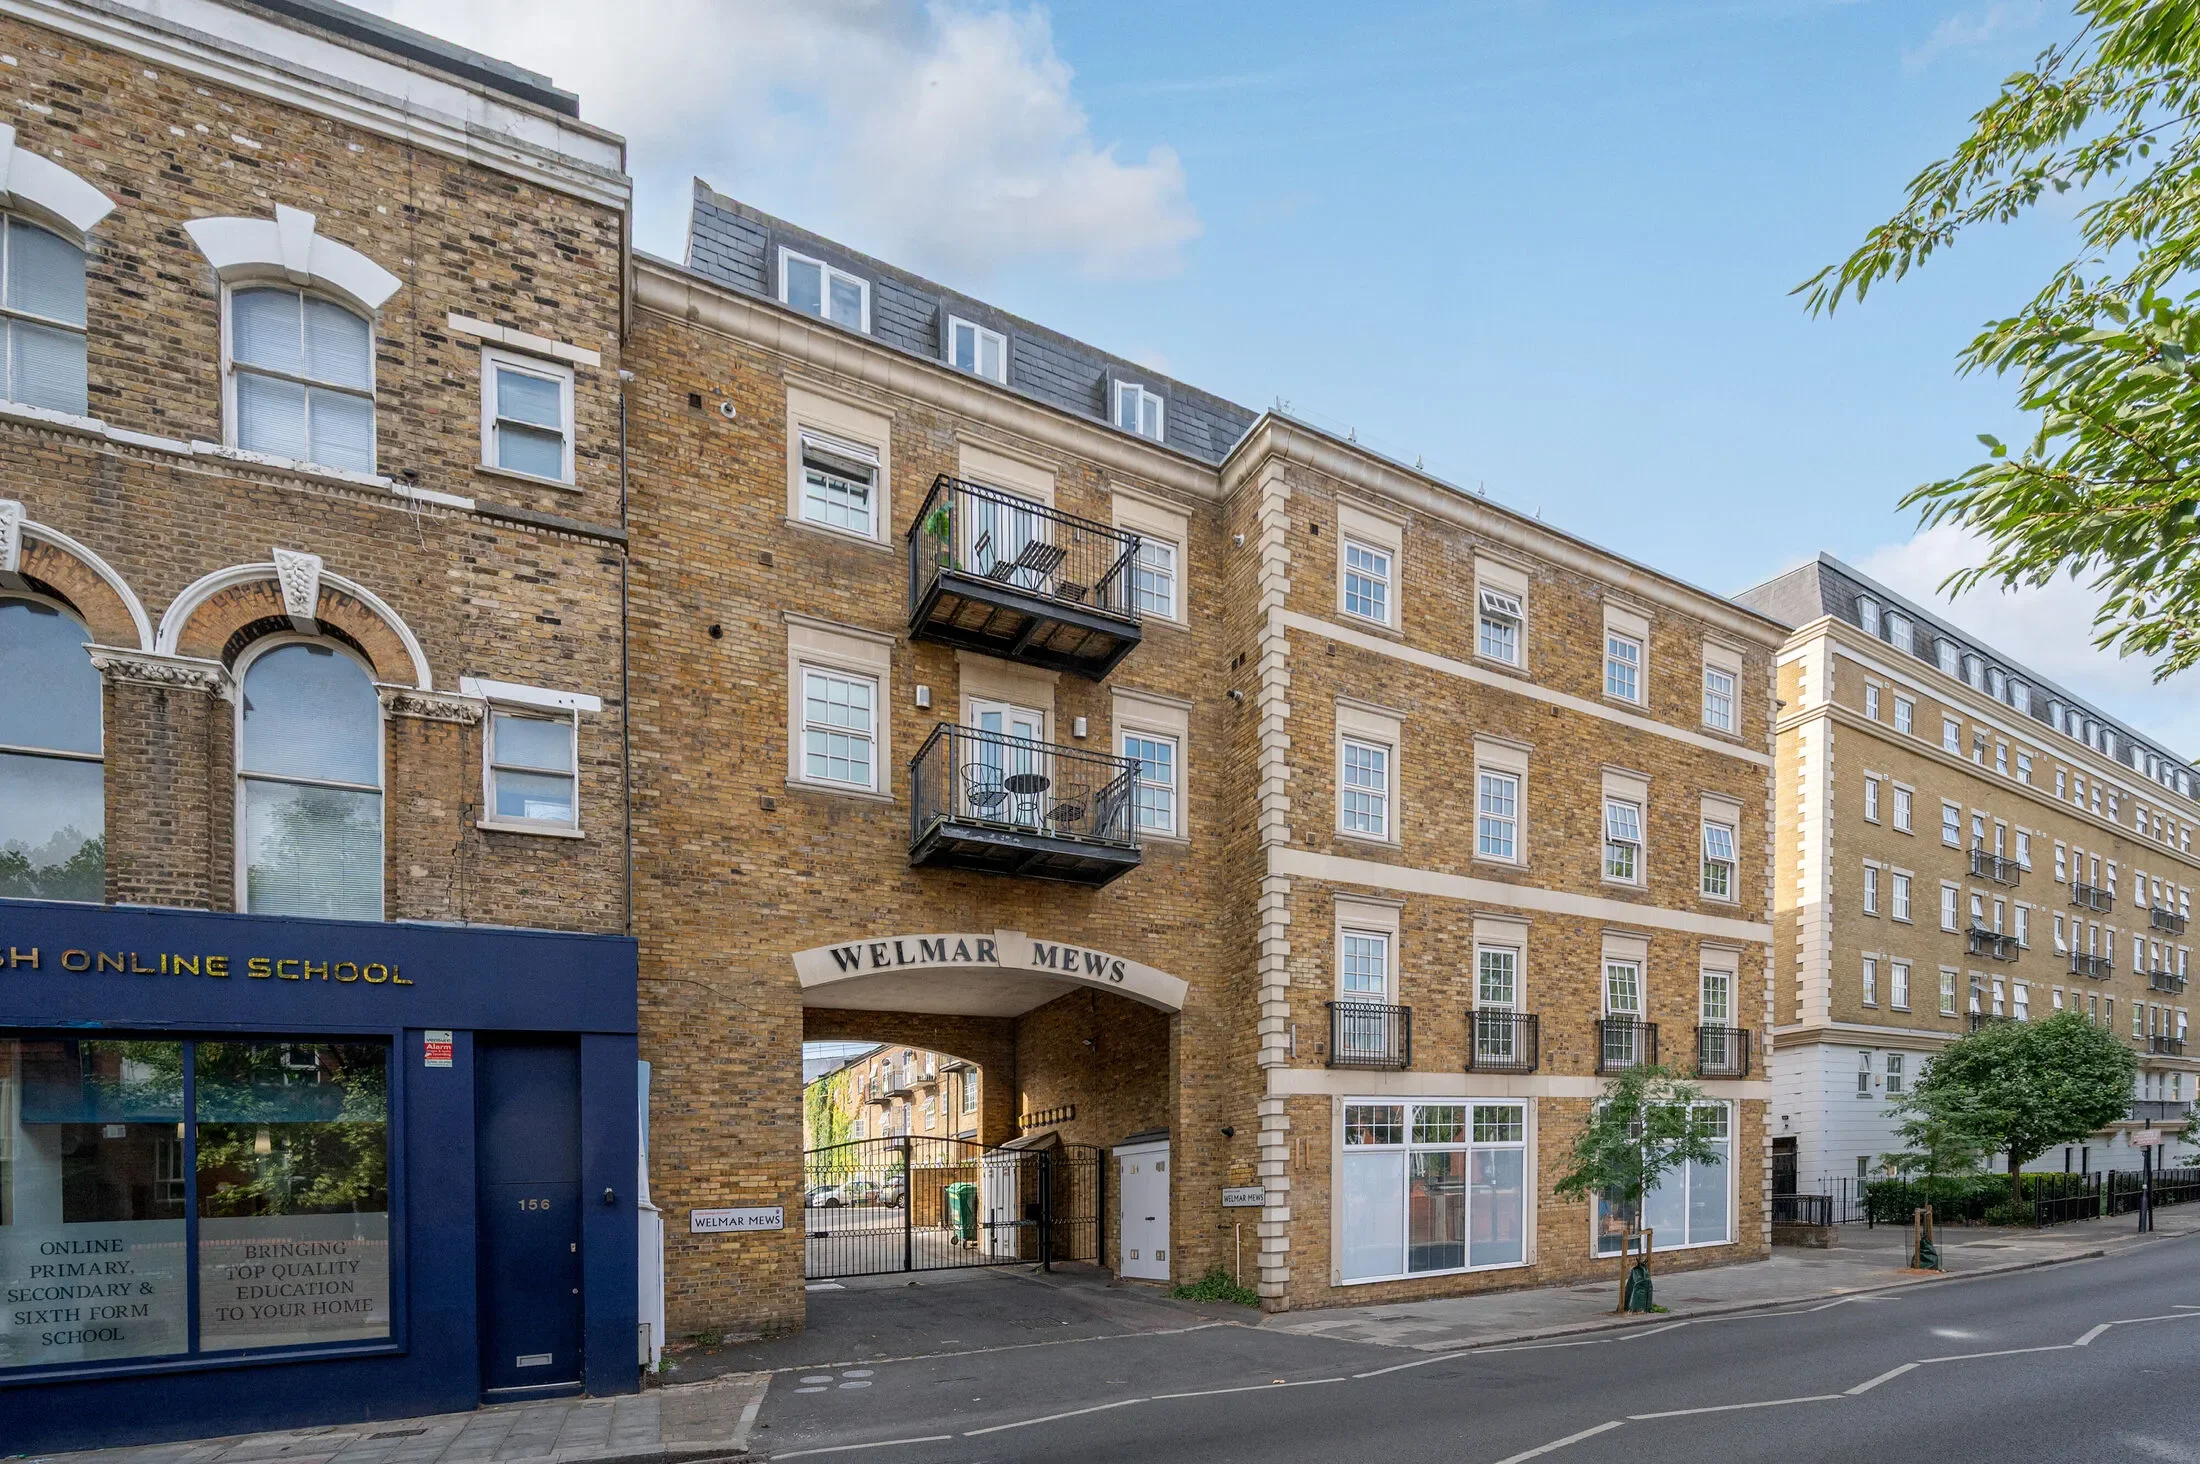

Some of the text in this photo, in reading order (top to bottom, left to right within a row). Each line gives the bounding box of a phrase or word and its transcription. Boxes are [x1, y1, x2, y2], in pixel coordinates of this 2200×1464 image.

[0, 946, 414, 985] H ONLINE SCHOOL
[830, 938, 1126, 983] WELMAR MEWS
[518, 1199, 550, 1211] 156
[1224, 1193, 1264, 1203] WELMAR MEWS
[695, 1215, 780, 1227] WELMAR MEWS
[40, 1239, 123, 1256] ONLINE
[245, 1241, 346, 1259] BRINGING
[30, 1260, 135, 1279] PRIMARY,
[224, 1260, 361, 1281] TOP QUALITY
[7, 1281, 154, 1303] SECONDARY &
[236, 1280, 354, 1300] EDUCATION
[14, 1303, 149, 1325] SIXTH FORM
[216, 1298, 373, 1322] TO YOUR HOME
[41, 1327, 125, 1346] SCHOOL
